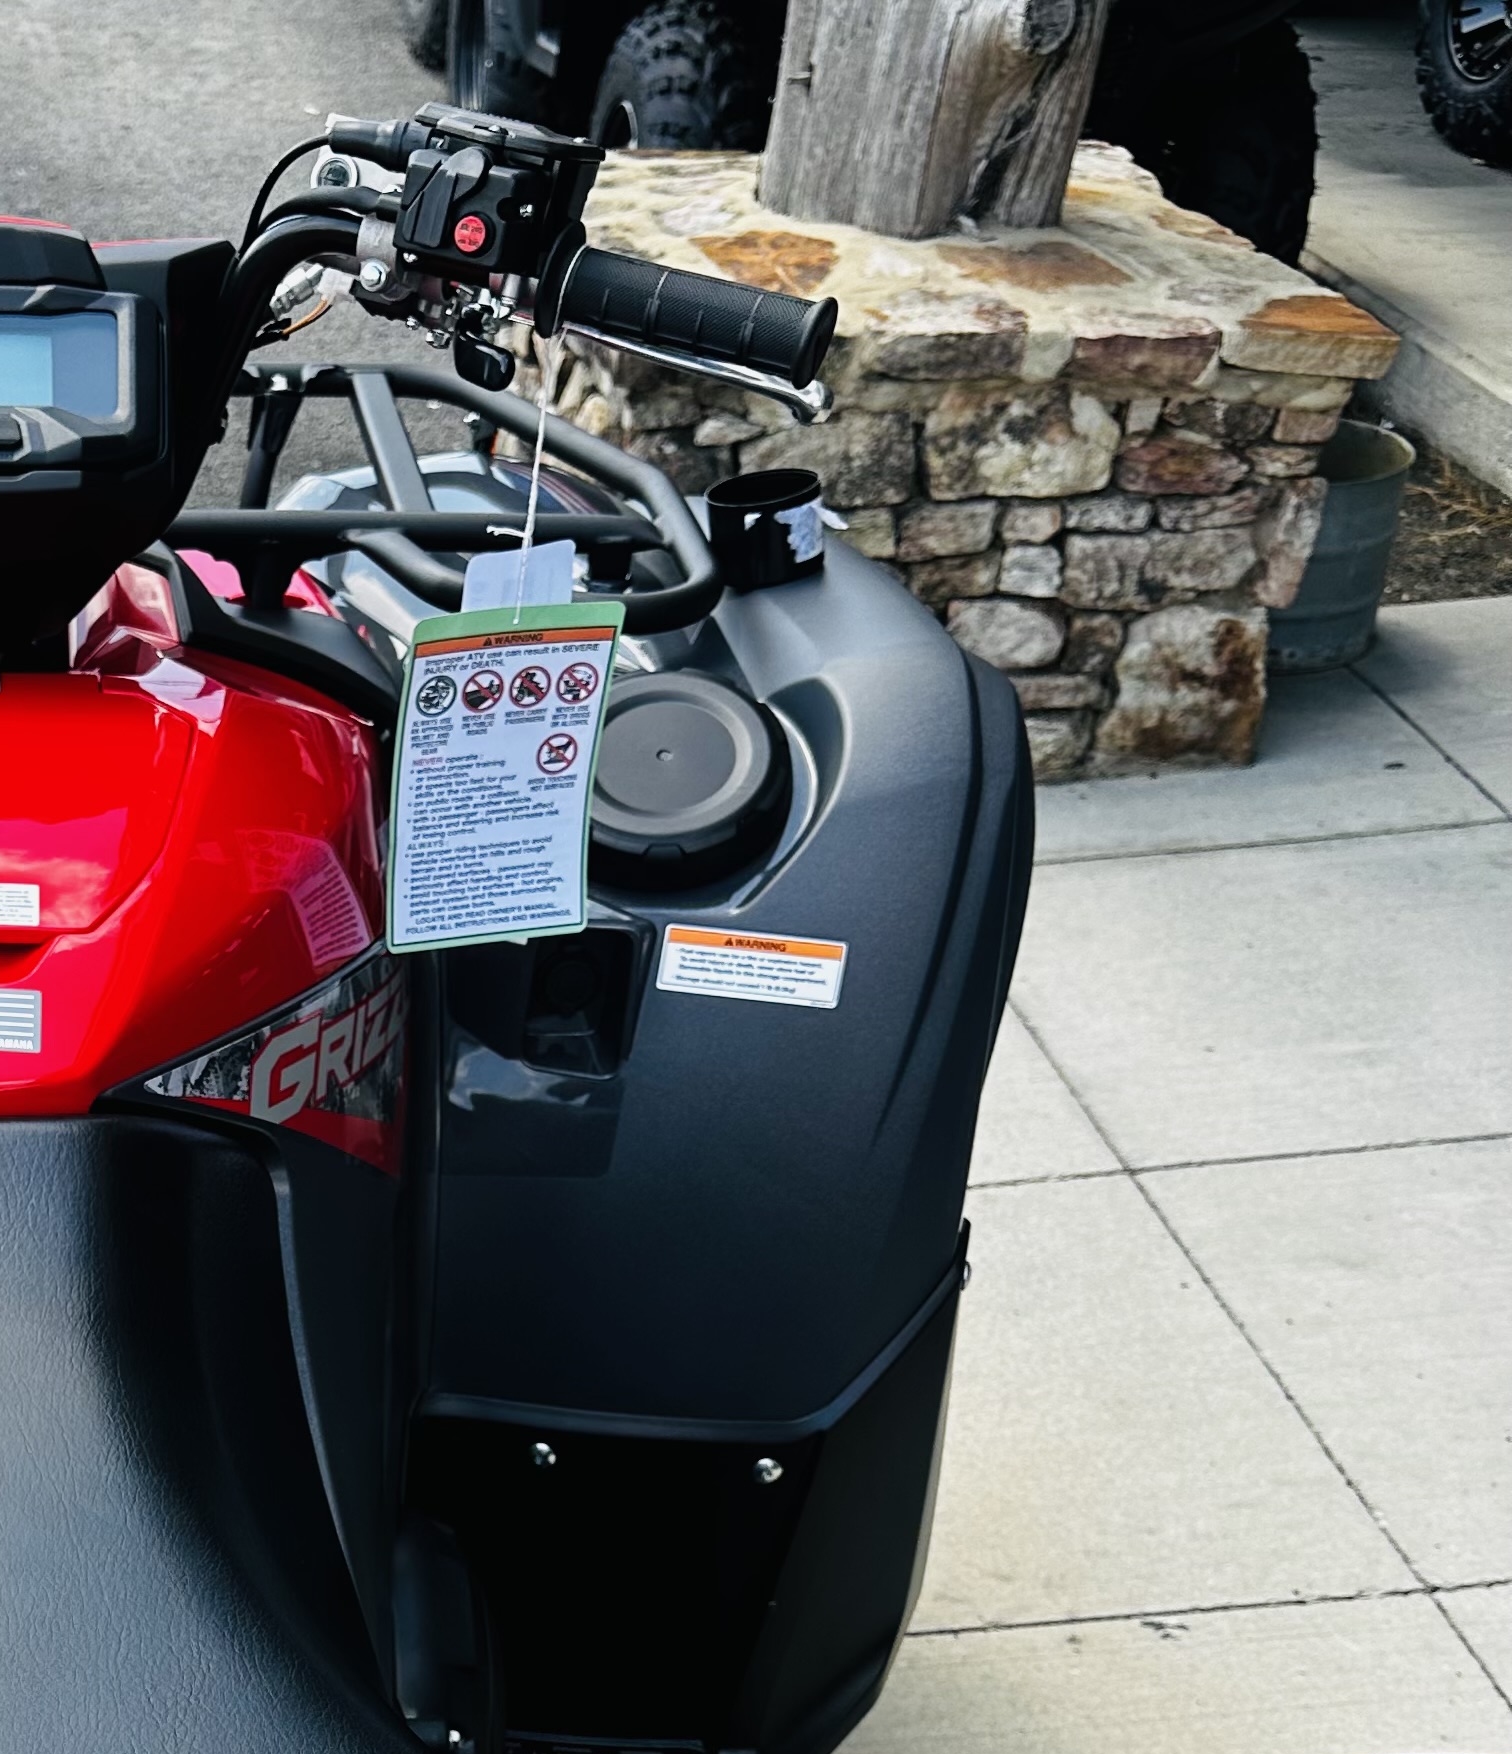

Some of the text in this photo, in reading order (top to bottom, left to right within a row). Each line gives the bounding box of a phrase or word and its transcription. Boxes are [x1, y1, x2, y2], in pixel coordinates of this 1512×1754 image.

[494, 632, 543, 645] WARNING
[424, 655, 465, 667] Improper
[466, 653, 484, 661] ATV
[522, 647, 549, 656] result
[561, 643, 600, 654] SEVERE
[423, 663, 458, 675] INJURY
[412, 753, 478, 766] NEVER operate
[416, 759, 505, 774] without proper training
[445, 820, 459, 828] and
[407, 839, 443, 850] ALWAYS
[405, 924, 436, 934] FOLLOW
[439, 922, 452, 930] ALL
[512, 914, 527, 922] AND
[415, 915, 445, 924] LOCATE
[735, 938, 786, 952] WARNING
